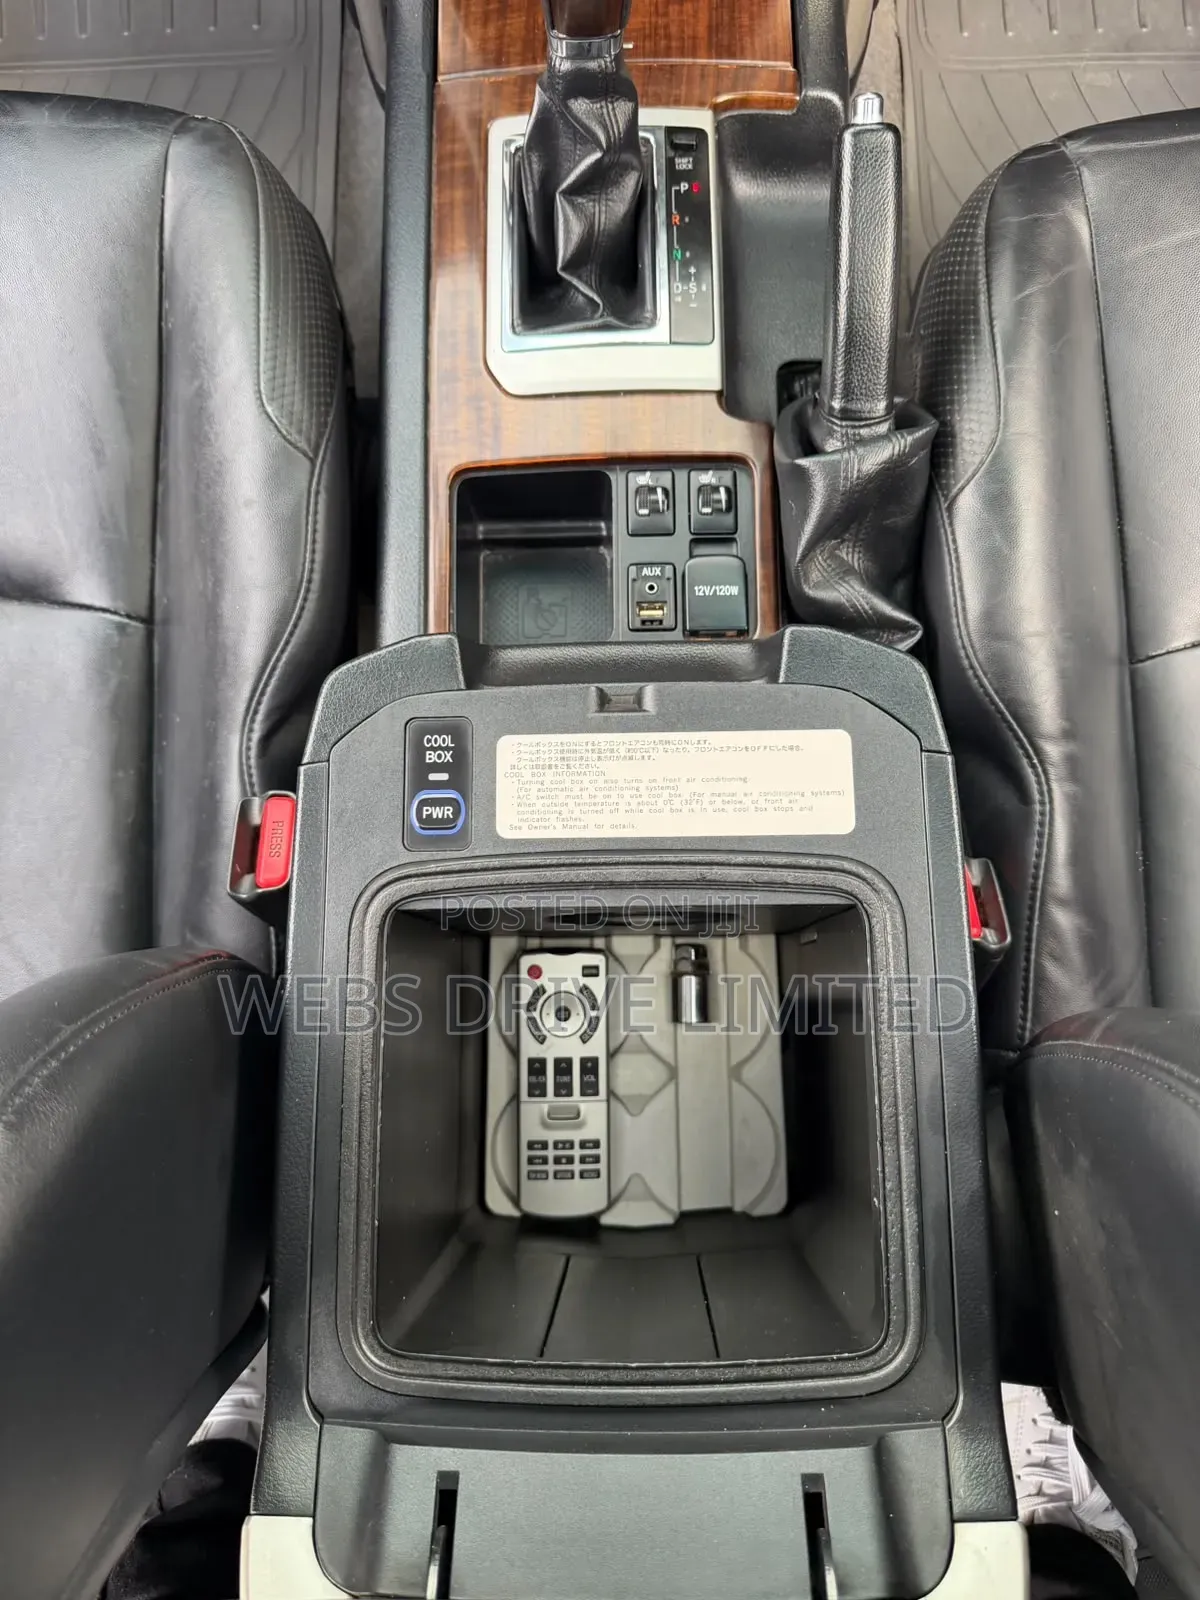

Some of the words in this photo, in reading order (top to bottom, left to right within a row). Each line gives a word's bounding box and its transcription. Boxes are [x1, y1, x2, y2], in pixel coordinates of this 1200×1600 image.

[680, 182, 689, 193] P
[672, 215, 680, 225] R
[673, 248, 681, 261] N
[642, 567, 661, 576] AUX
[694, 585, 739, 596] 12V/120W
[423, 735, 455, 747] COOL
[425, 751, 453, 763] BOX
[422, 807, 453, 818] PWR
[268, 820, 285, 859] PRESS
